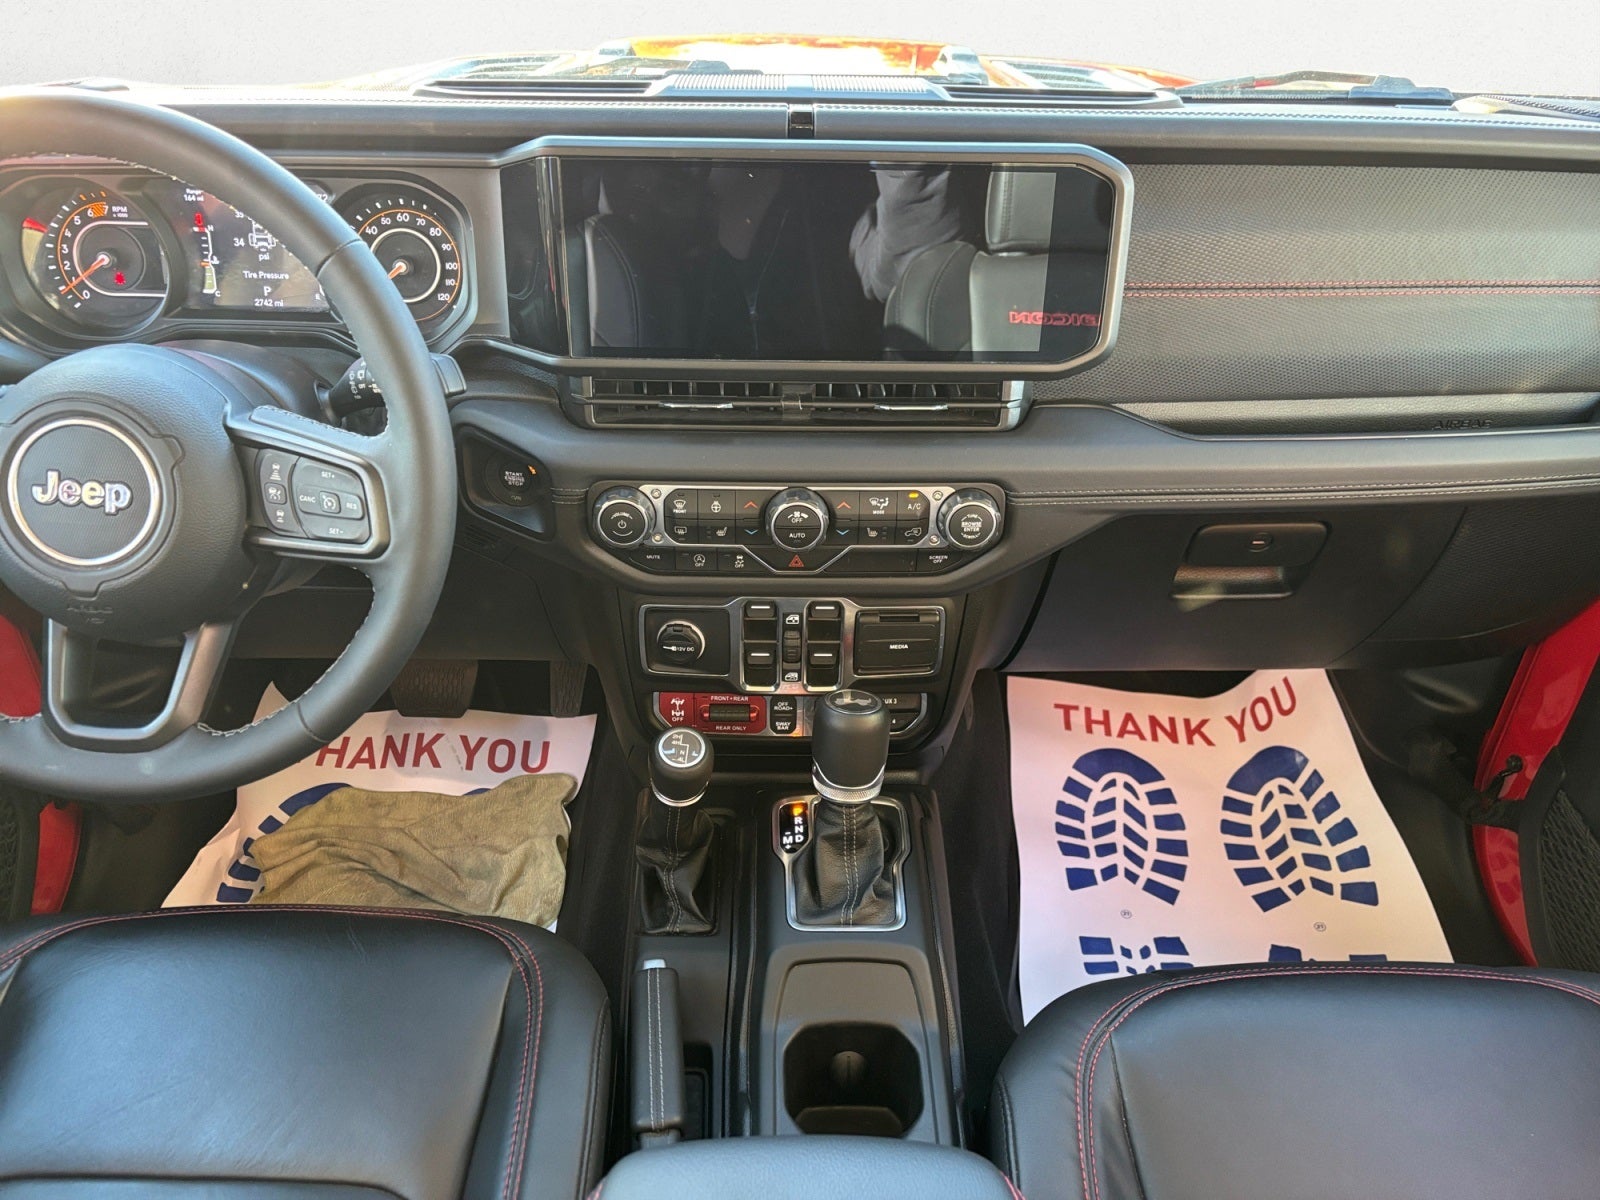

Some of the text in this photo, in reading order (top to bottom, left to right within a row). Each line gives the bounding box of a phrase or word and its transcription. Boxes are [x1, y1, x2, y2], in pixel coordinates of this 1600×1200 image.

[87, 208, 93, 217] 6
[103, 205, 109, 215] 7
[73, 216, 81, 225] 5
[381, 217, 391, 225] 50
[396, 213, 410, 222] 60
[416, 217, 426, 226] 70
[64, 228, 72, 238] 4
[365, 226, 378, 234] 40
[429, 227, 442, 236] 80
[233, 237, 245, 247] 34
[61, 244, 69, 254] 3
[441, 243, 452, 251] 90
[258, 253, 270, 262] psi
[63, 260, 71, 271] 2
[445, 262, 458, 270] 100
[242, 270, 289, 280] Tire Pressure
[445, 278, 456, 286] 110
[82, 290, 91, 299] 0
[263, 285, 272, 296] P
[437, 293, 450, 301] 120
[254, 298, 284, 307] 2742 mi
[321, 471, 335, 479] SET+
[31, 469, 133, 515] Jeep
[299, 495, 316, 503] CANC
[1053, 676, 1298, 746] THANK YOU
[297, 732, 551, 773] HANK YOU
[794, 816, 803, 825] R
[794, 825, 804, 834] N
[782, 835, 793, 844] M
[795, 834, 804, 843] D
